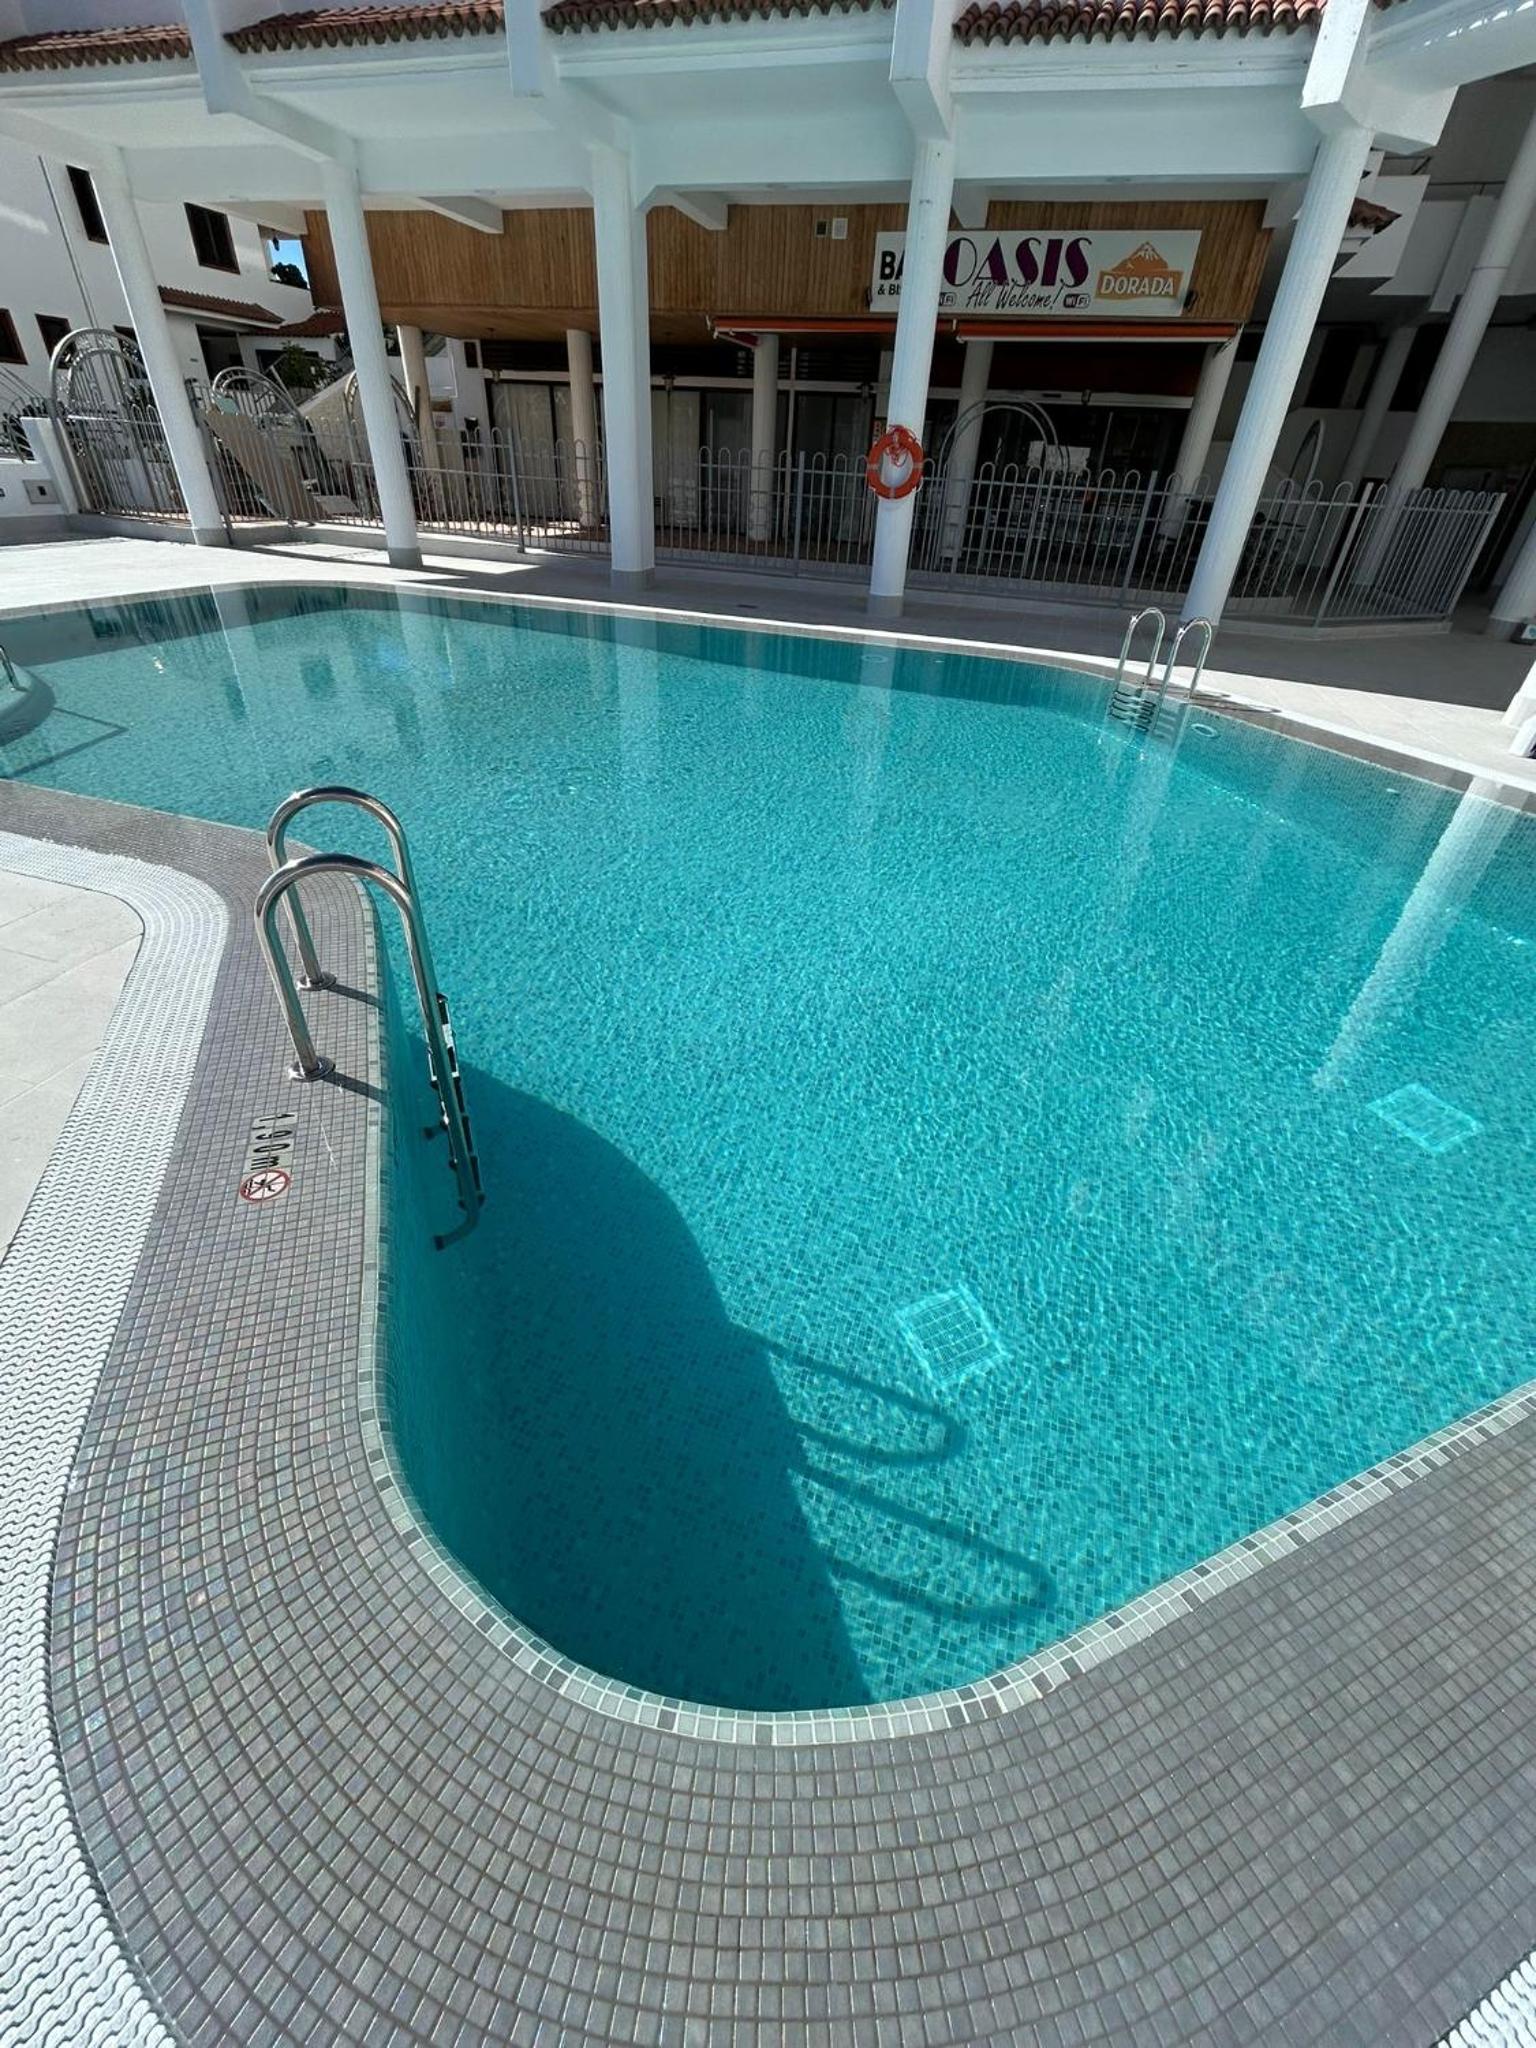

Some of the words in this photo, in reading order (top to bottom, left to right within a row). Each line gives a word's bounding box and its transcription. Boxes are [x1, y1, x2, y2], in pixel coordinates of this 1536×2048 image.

[943, 237, 1092, 288] OASIS
[966, 281, 996, 308] All
[996, 283, 1064, 310] Welcome!
[1101, 275, 1174, 296] DORADA
